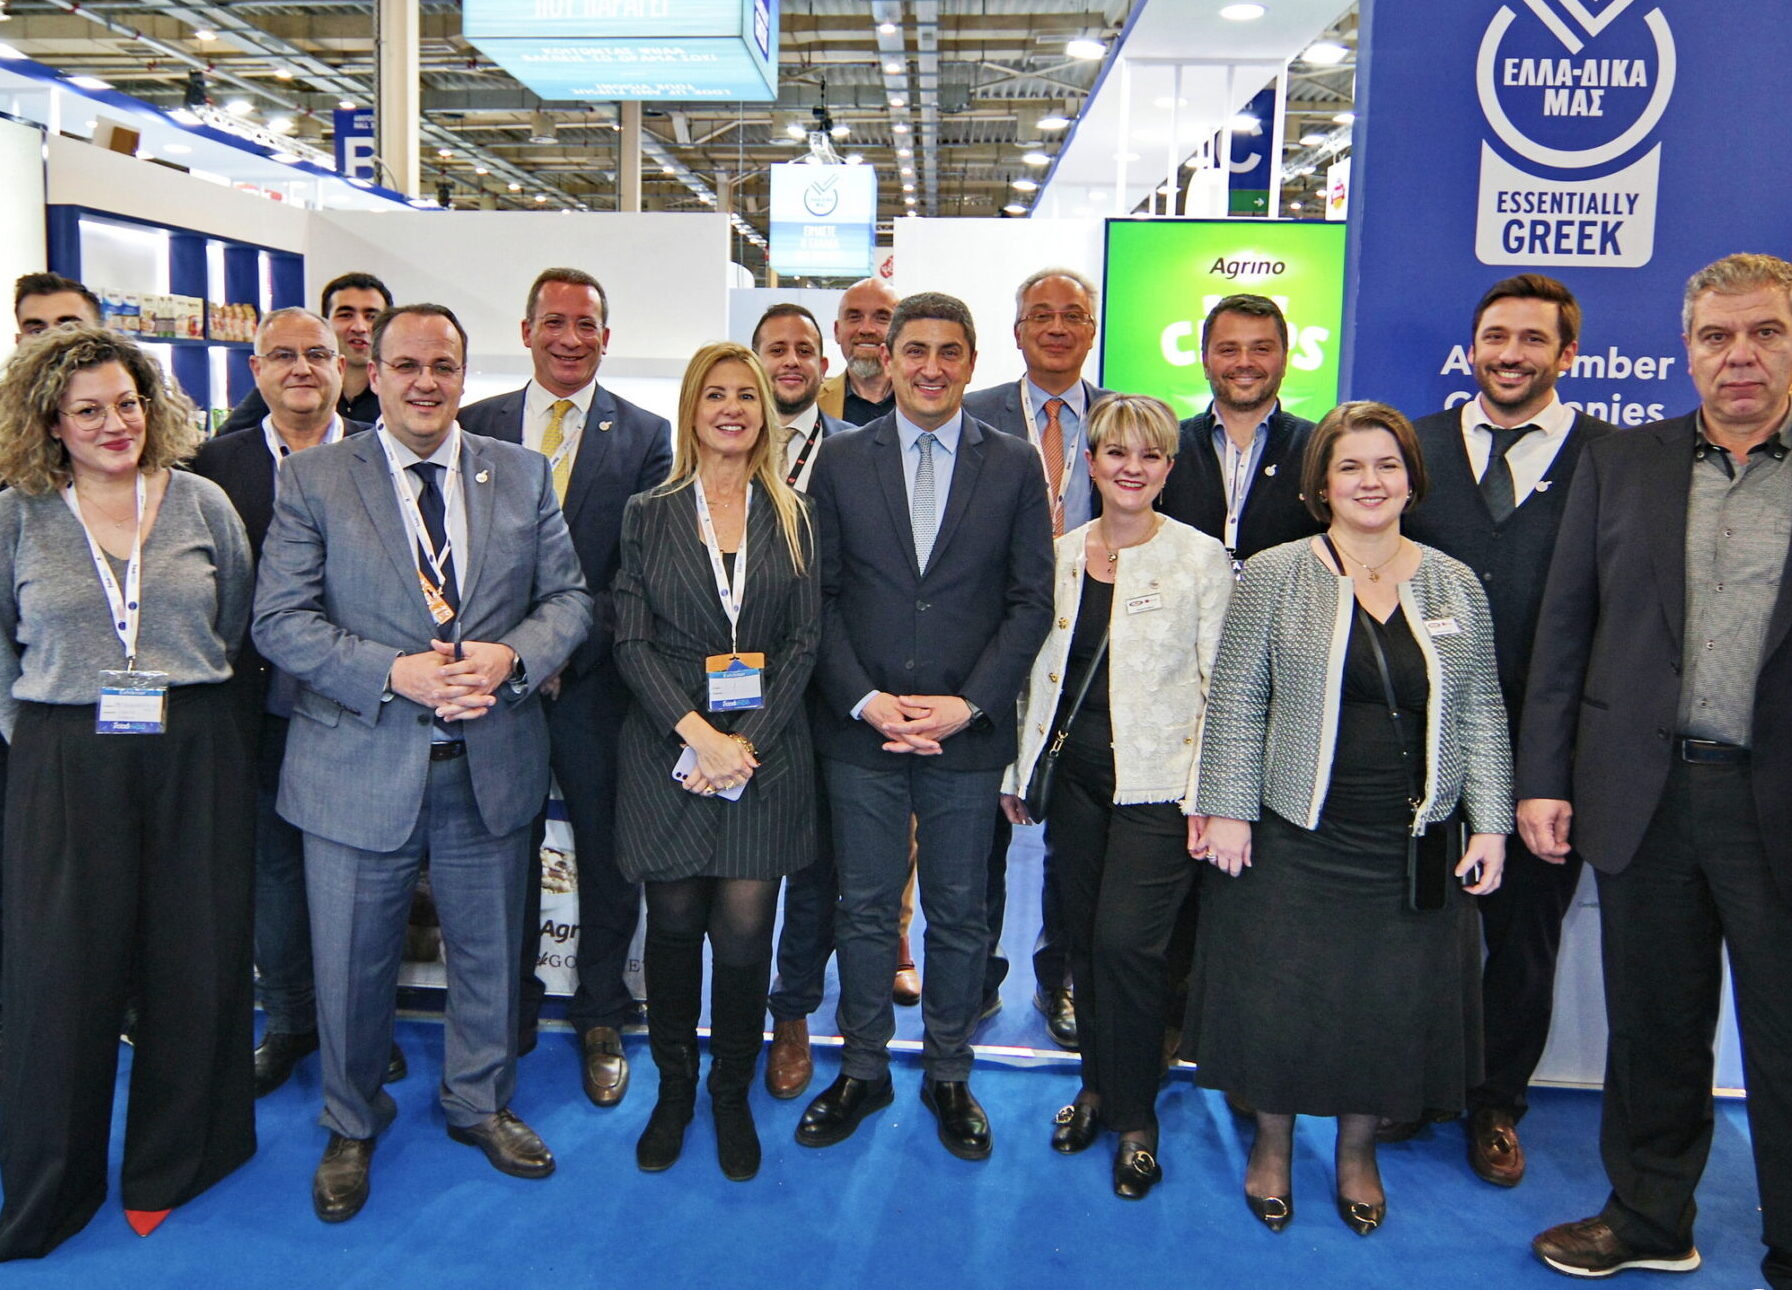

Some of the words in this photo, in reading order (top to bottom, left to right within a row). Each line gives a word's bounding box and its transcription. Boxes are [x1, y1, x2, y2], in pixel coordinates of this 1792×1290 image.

[1543, 88, 1605, 117] ΜΑΣ
[1496, 191, 1640, 216] ESSENTIALLY
[1502, 218, 1624, 256] GREEK
[1209, 257, 1286, 280] Agrino
[1559, 346, 1676, 380] mber
[540, 919, 580, 944] Agr
